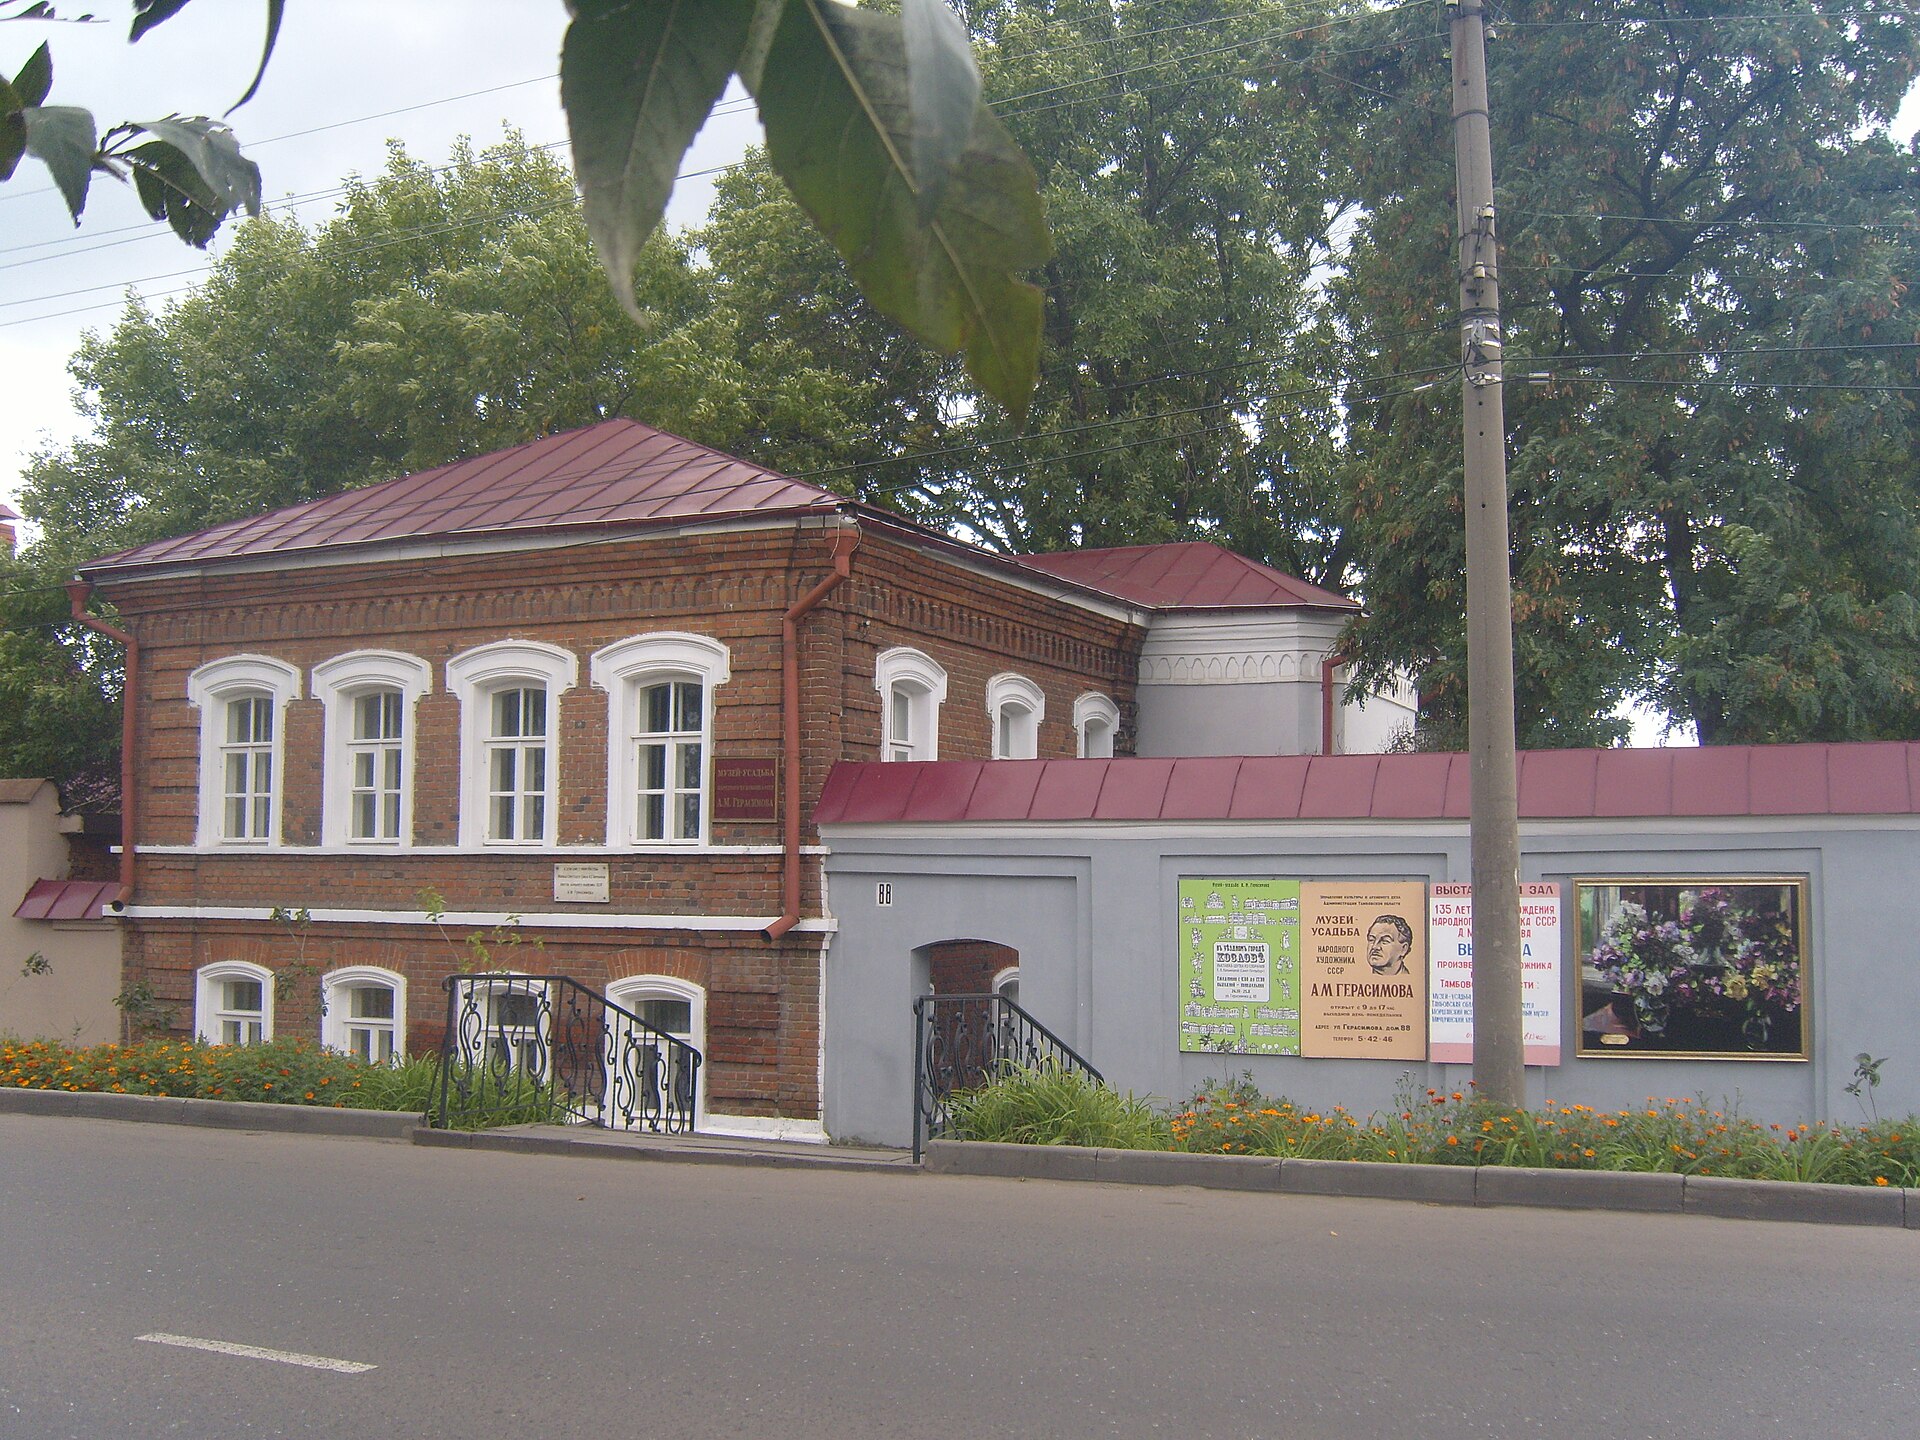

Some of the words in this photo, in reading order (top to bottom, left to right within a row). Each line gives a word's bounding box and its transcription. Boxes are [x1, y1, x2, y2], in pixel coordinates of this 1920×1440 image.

[879, 883, 891, 904] 88
[1529, 885, 1554, 895] ЗАЛ
[1435, 904, 1452, 915] 135
[1455, 905, 1471, 915] ЛЕТ
[1520, 905, 1555, 915] ЖДЕНИЯ
[1432, 917, 1472, 927] НАРОДНОГ
[1535, 916, 1557, 927] СССР
[1311, 927, 1360, 936] УСАДЬБА
[1317, 945, 1354, 954] НАРОДНОГО
[1316, 956, 1356, 964] ХУДОЖНИКА
[1437, 960, 1472, 969] ПРОИЗВЕ
[1520, 961, 1552, 970] ОЖНИКА
[1327, 967, 1345, 975] СССР
[1440, 979, 1472, 989] ТАМБОВ
[1336, 983, 1414, 998] ГЕРАСИМОВА
